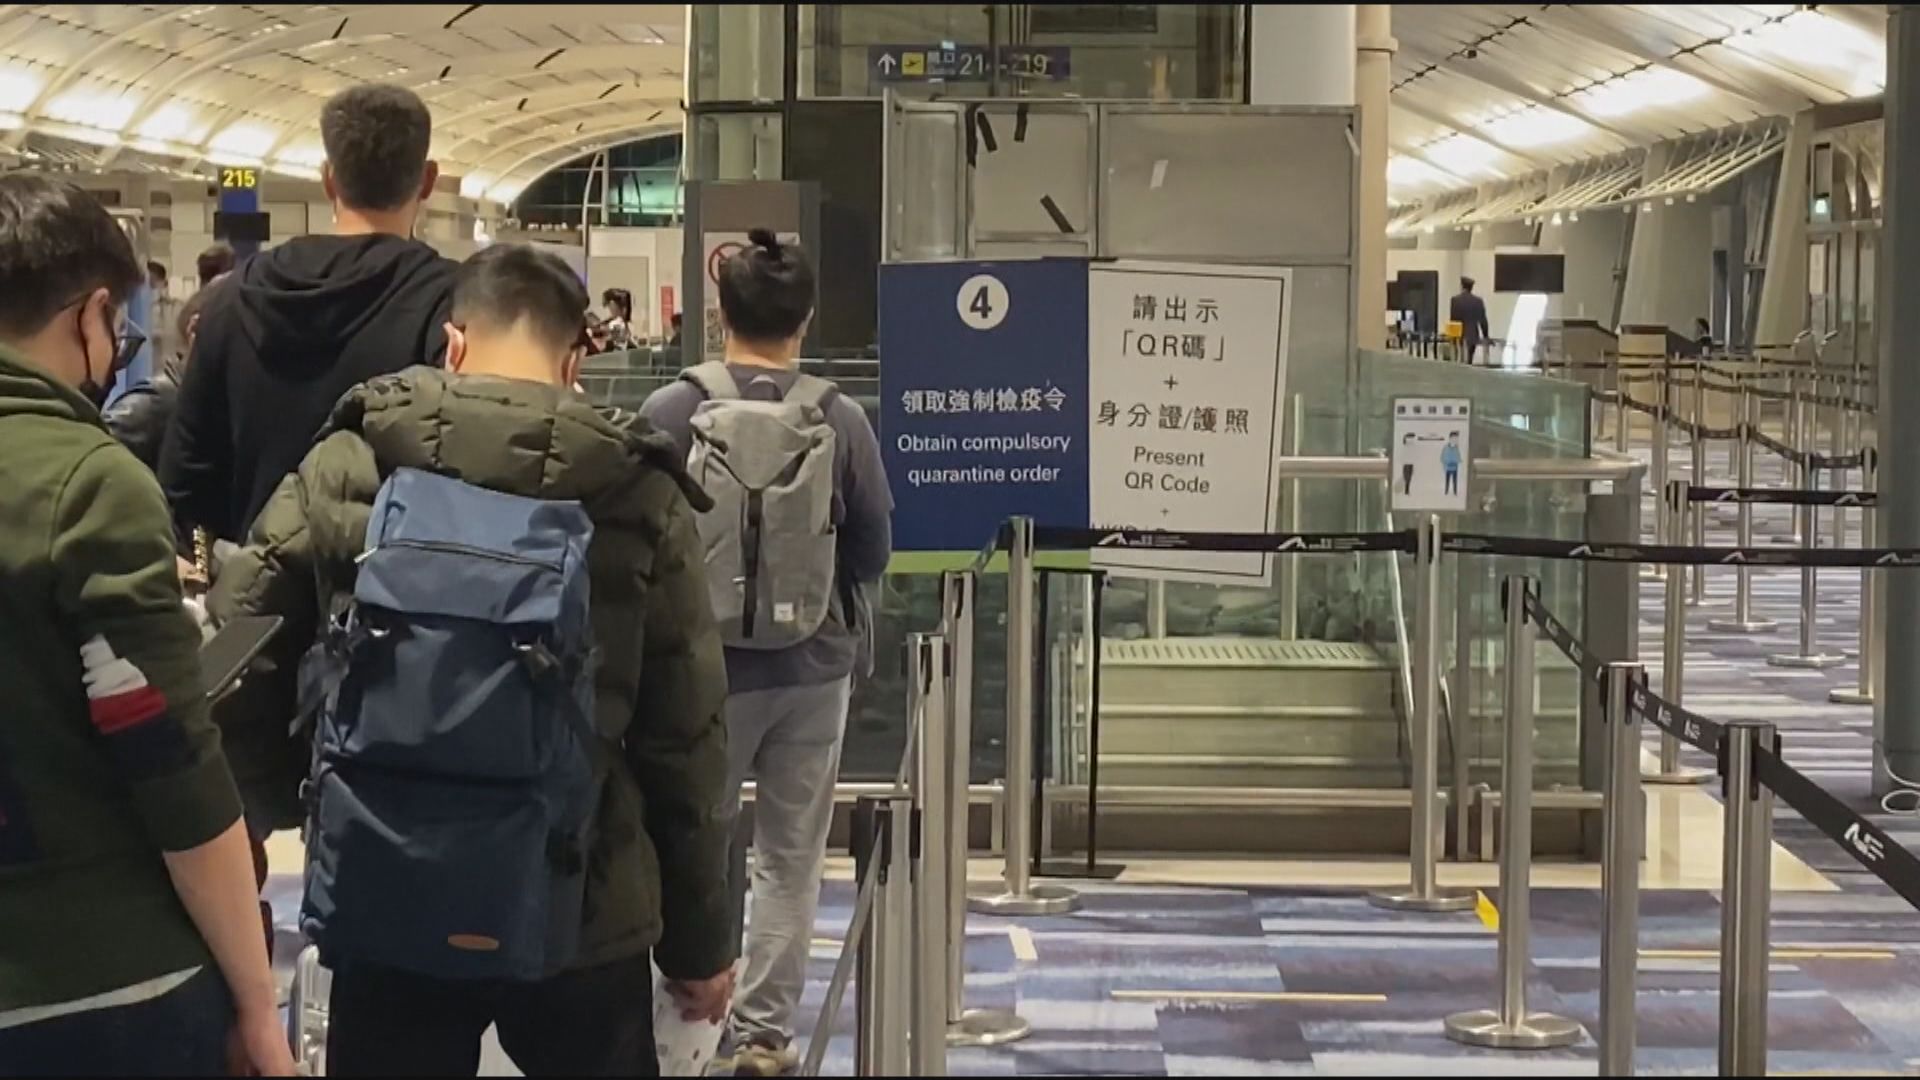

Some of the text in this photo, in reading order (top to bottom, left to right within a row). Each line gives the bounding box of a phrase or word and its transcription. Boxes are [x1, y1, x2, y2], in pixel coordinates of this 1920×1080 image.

[223, 170, 255, 187] 215
[969, 285, 993, 319] 4
[1133, 294, 1219, 323] 請出示
[901, 386, 1067, 413] 領取強制檢疫令
[1097, 400, 1250, 434] 身分證/護照
[897, 432, 1071, 454] Obtain compulsory
[1133, 446, 1205, 467] Present
[908, 464, 1062, 487] quarantine order
[1124, 471, 1211, 493] QR Code
